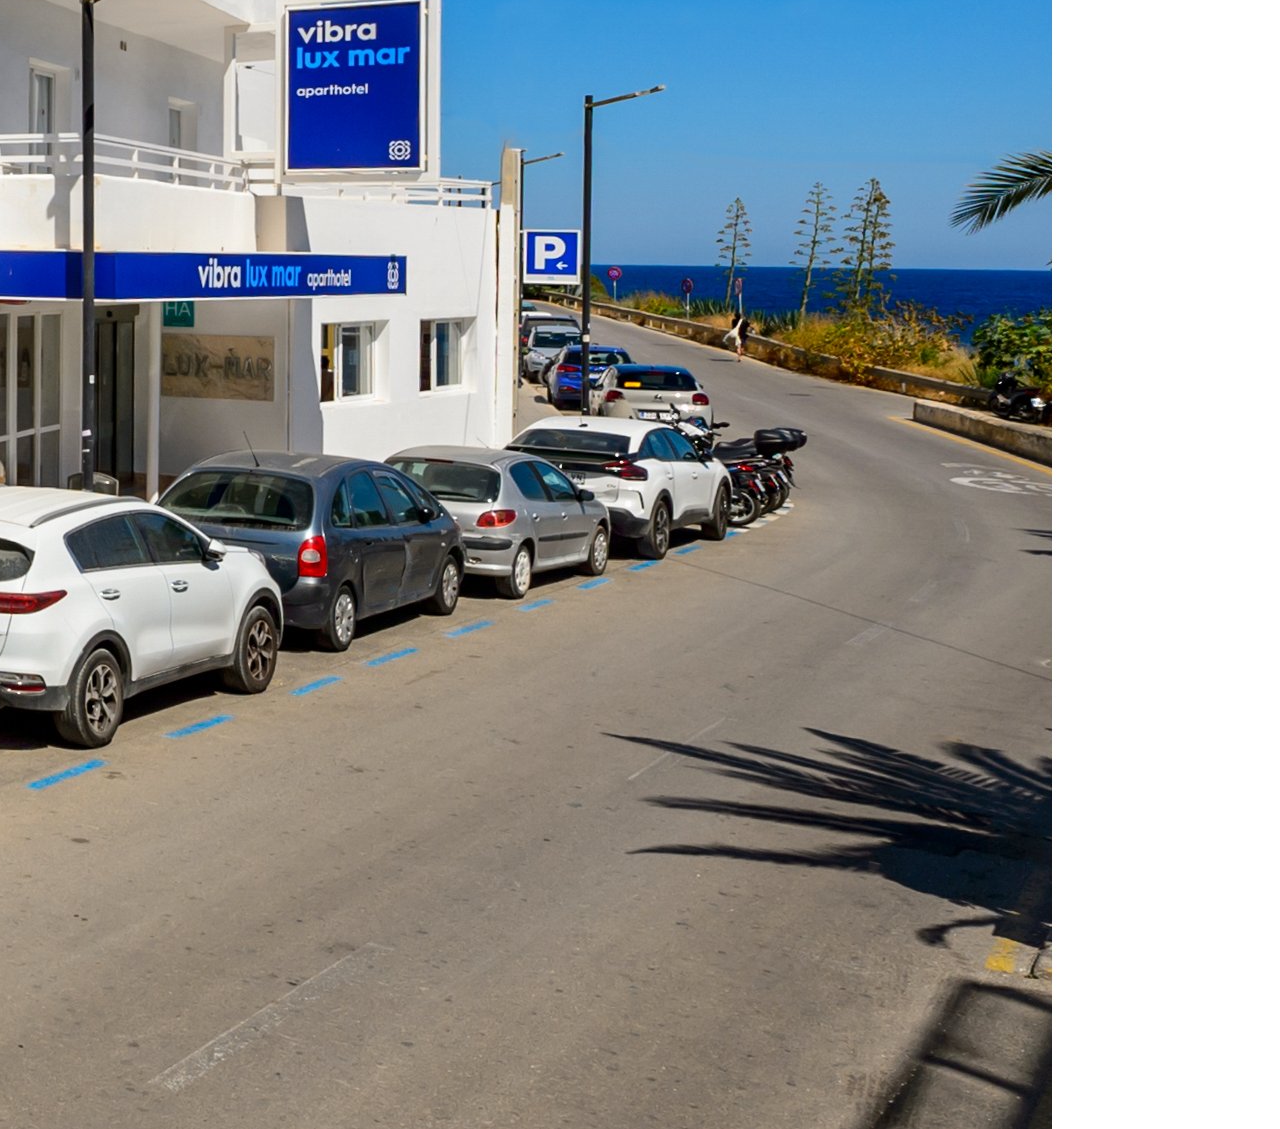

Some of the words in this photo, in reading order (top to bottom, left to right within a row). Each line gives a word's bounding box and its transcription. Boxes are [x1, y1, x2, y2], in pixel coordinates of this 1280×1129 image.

[296, 20, 377, 45] vibra
[296, 46, 340, 70] lux
[347, 46, 411, 67] mar
[296, 82, 369, 99] aparthotel
[534, 235, 566, 270] P
[197, 258, 242, 289] vibra
[245, 258, 269, 288] lux
[271, 264, 302, 288] mar
[306, 268, 352, 290] aparthotel
